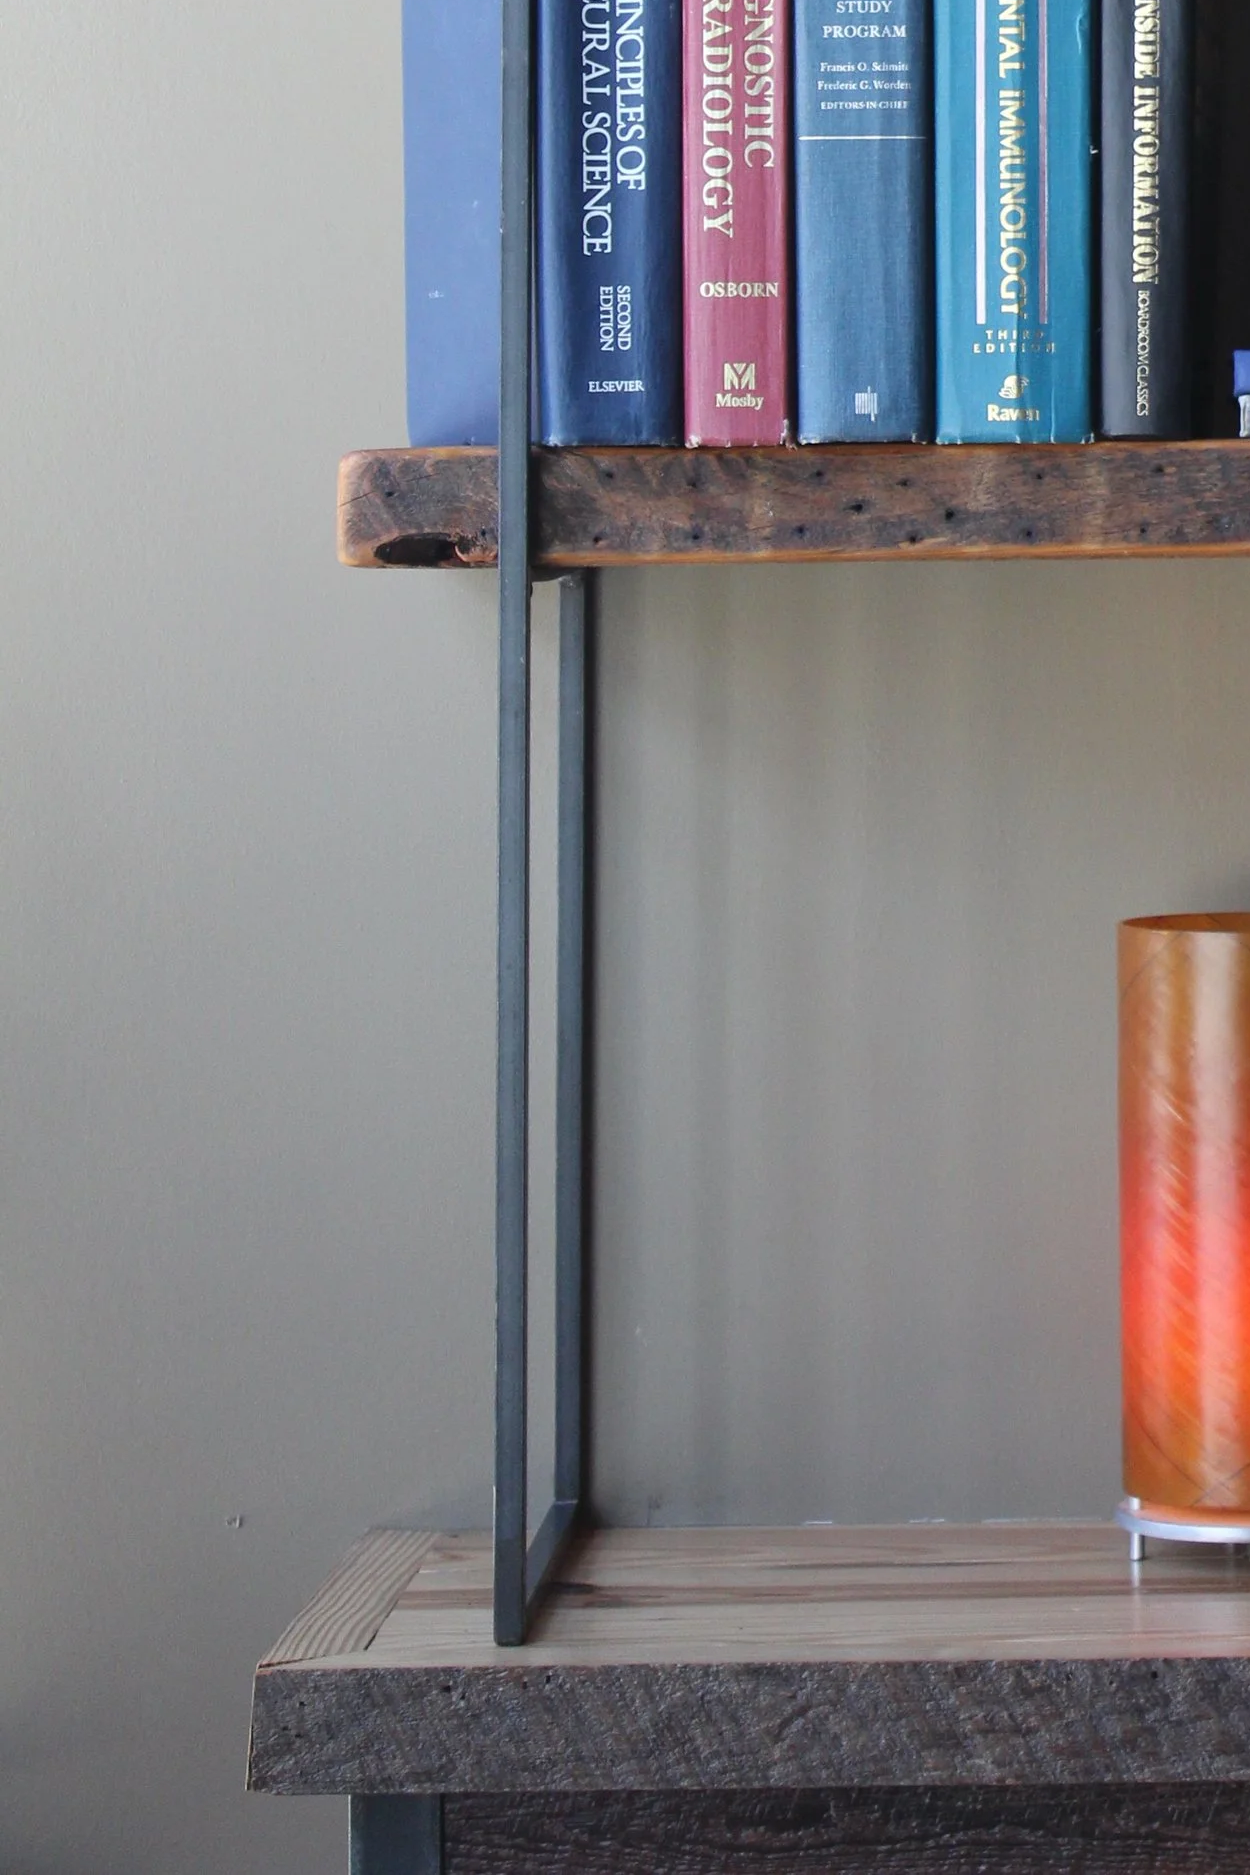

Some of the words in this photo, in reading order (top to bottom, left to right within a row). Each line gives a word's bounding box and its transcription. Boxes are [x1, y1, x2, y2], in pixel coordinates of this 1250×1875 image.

[835, 0, 893, 15] STUDY
[822, 25, 907, 39] PROGRAM
[820, 62, 856, 73] Francis
[857, 62, 870, 73] O.
[817, 80, 858, 91] Frederic
[859, 80, 872, 91] G.
[872, 80, 912, 91] Worden
[616, 145, 646, 191] OF
[582, 111, 612, 256] SCIENCE
[1132, 85, 1159, 285] INFORMATION
[999, 89, 1027, 320] IMMUNOLOGY
[699, 281, 780, 298] OSBORN
[599, 285, 615, 352] EDITION
[616, 285, 632, 351] SECOND
[1136, 289, 1151, 365] BOARDROOM
[985, 330, 1044, 340] THIRD
[973, 342, 1056, 354] EDITION
[588, 380, 645, 393] ELSEVIER
[1135, 365, 1150, 417] CLASSICS
[715, 393, 765, 411] Mosby
[987, 404, 1040, 422] Raven
